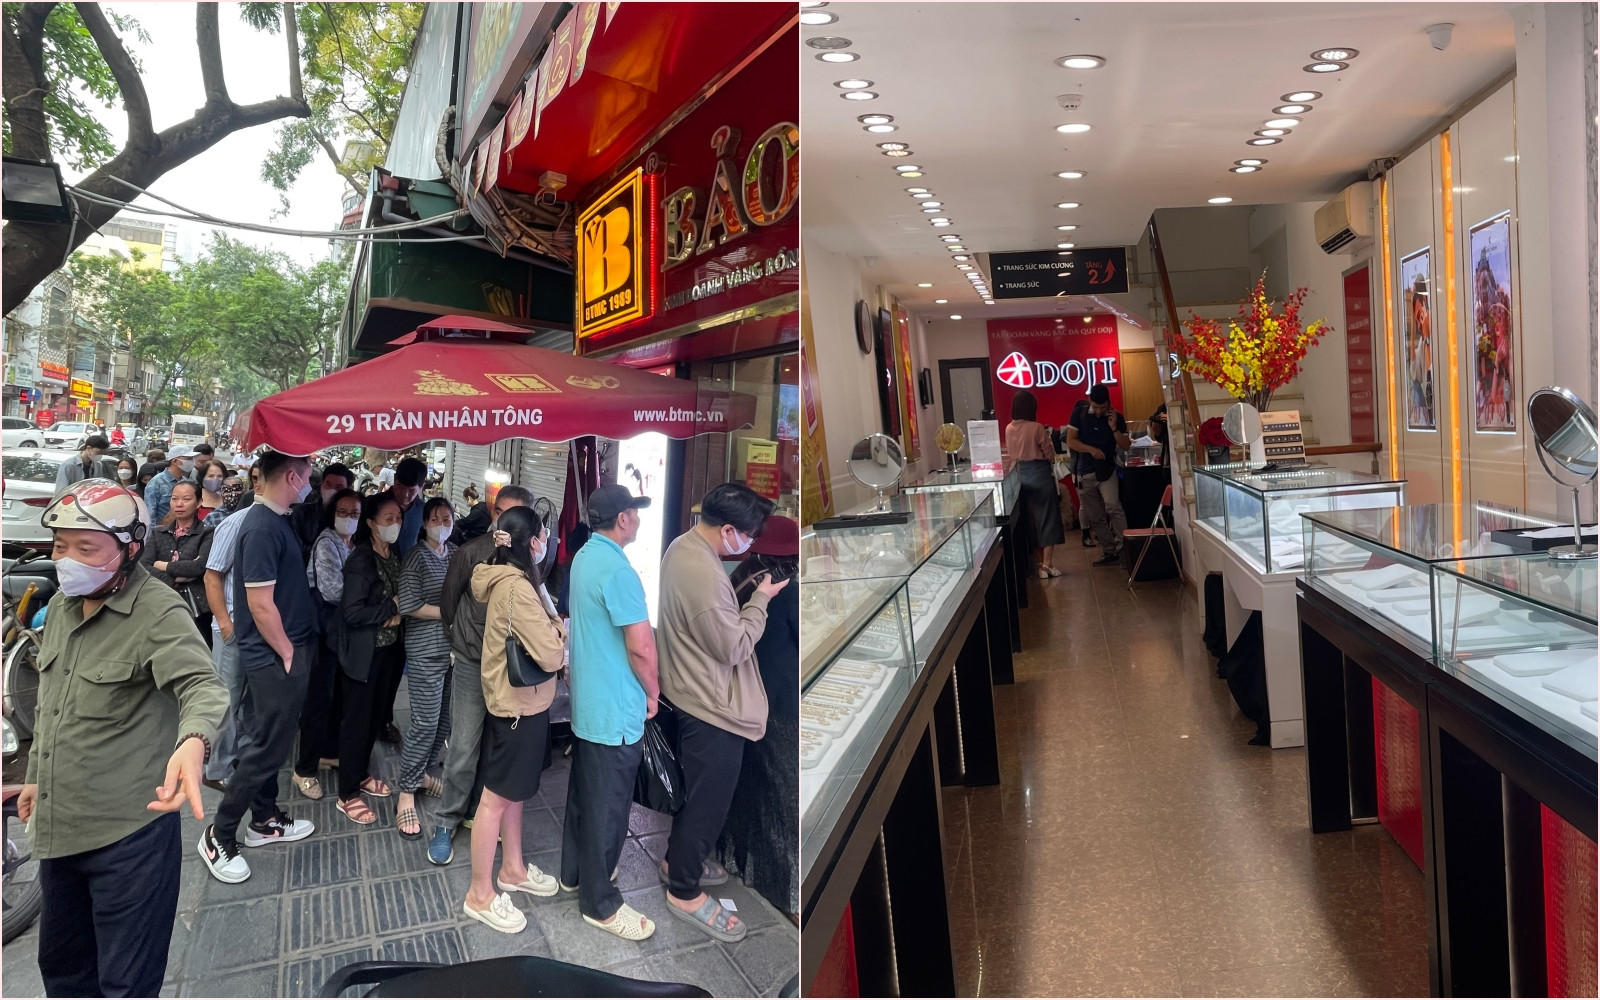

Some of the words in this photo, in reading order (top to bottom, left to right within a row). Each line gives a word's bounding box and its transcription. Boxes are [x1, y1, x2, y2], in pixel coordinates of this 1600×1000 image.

[661, 121, 799, 272] BẢO
[726, 266, 763, 288] VÀNG
[1088, 269, 1099, 285] 2
[585, 300, 607, 321] BTMC
[609, 289, 631, 311] 1989
[1034, 357, 1118, 396] DOJI
[326, 414, 355, 434] 29
[360, 407, 423, 432] TRẦN
[428, 406, 487, 429] NHÂN
[491, 405, 543, 426] TÔNG
[633, 406, 724, 422] www.btmc.vn
